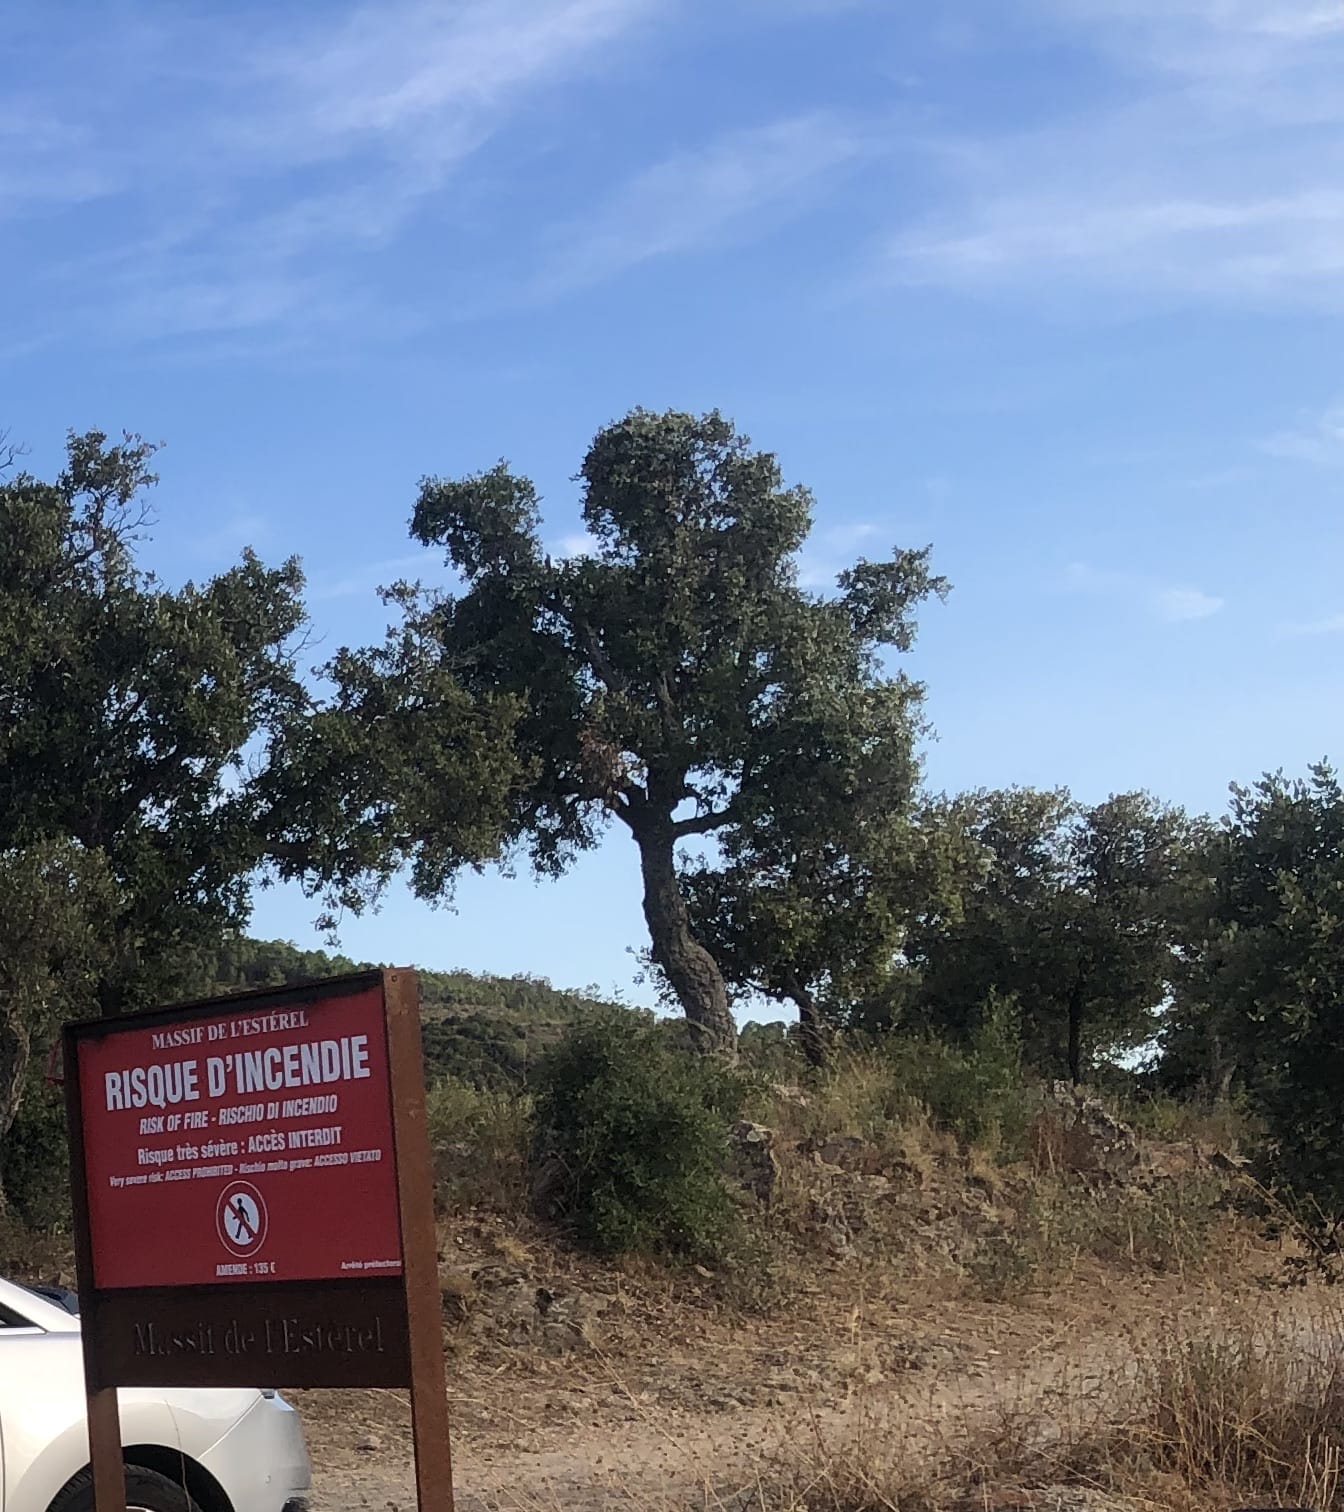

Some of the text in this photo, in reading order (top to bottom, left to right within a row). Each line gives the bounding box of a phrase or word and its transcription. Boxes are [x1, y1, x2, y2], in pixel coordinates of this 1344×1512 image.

[152, 1010, 309, 1049] MASSIF DE L'ESTÉREL
[104, 1035, 371, 1111] RISQUE D'INCENDIE
[139, 1116, 164, 1134] RISK
[167, 1114, 182, 1131] OF
[184, 1111, 209, 1129] FIRE
[218, 1103, 264, 1125] RISCHIO
[266, 1101, 279, 1120] DI
[282, 1094, 338, 1118] INCENDIO
[137, 1148, 174, 1167] Risque
[176, 1143, 199, 1160] très
[201, 1139, 238, 1158] sévère
[248, 1128, 285, 1153] ACCÈS
[288, 1126, 342, 1149] INTERDIT
[109, 1176, 125, 1188] Very
[165, 1168, 192, 1181] ACCESS
[216, 1263, 248, 1276] AMENDE
[254, 1262, 270, 1274] 135
[223, 1319, 254, 1353] de
